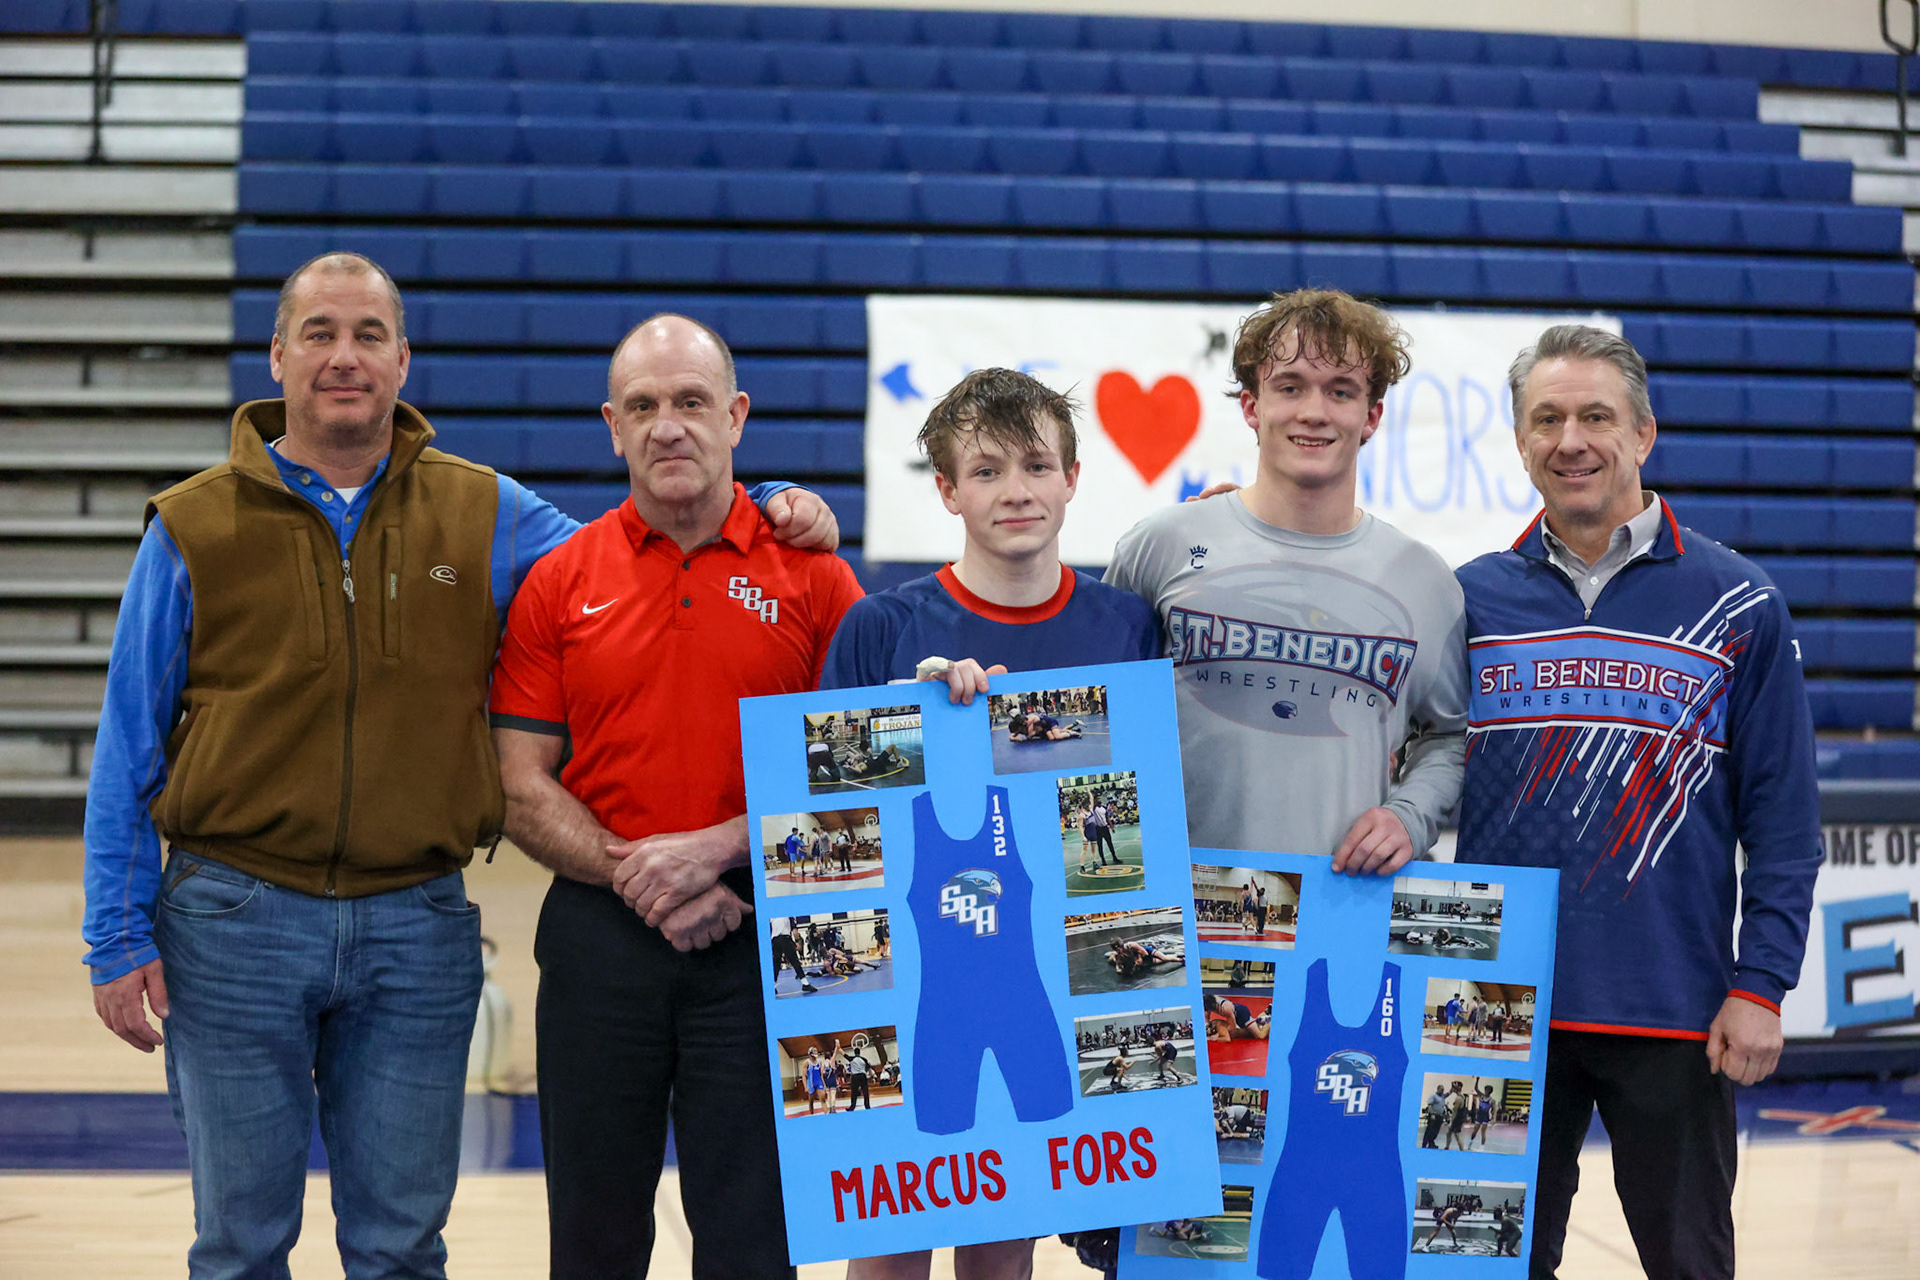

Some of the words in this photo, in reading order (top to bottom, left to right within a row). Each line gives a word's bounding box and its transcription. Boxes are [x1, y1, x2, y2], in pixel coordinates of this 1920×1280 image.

[728, 576, 779, 625] SBA
[1196, 669, 1377, 707] WRESTLING
[1479, 664, 1522, 693] ST.
[1535, 660, 1703, 706] BENEDICT
[1500, 693, 1670, 714] WRESTLING
[992, 795, 1007, 856] 132
[1820, 828, 1876, 866] ME
[940, 884, 997, 936] SBA
[1380, 978, 1394, 1037] 160
[1316, 1063, 1370, 1115] SBA
[830, 1149, 1007, 1223] MARCUS
[1047, 1126, 1157, 1190] FORS
